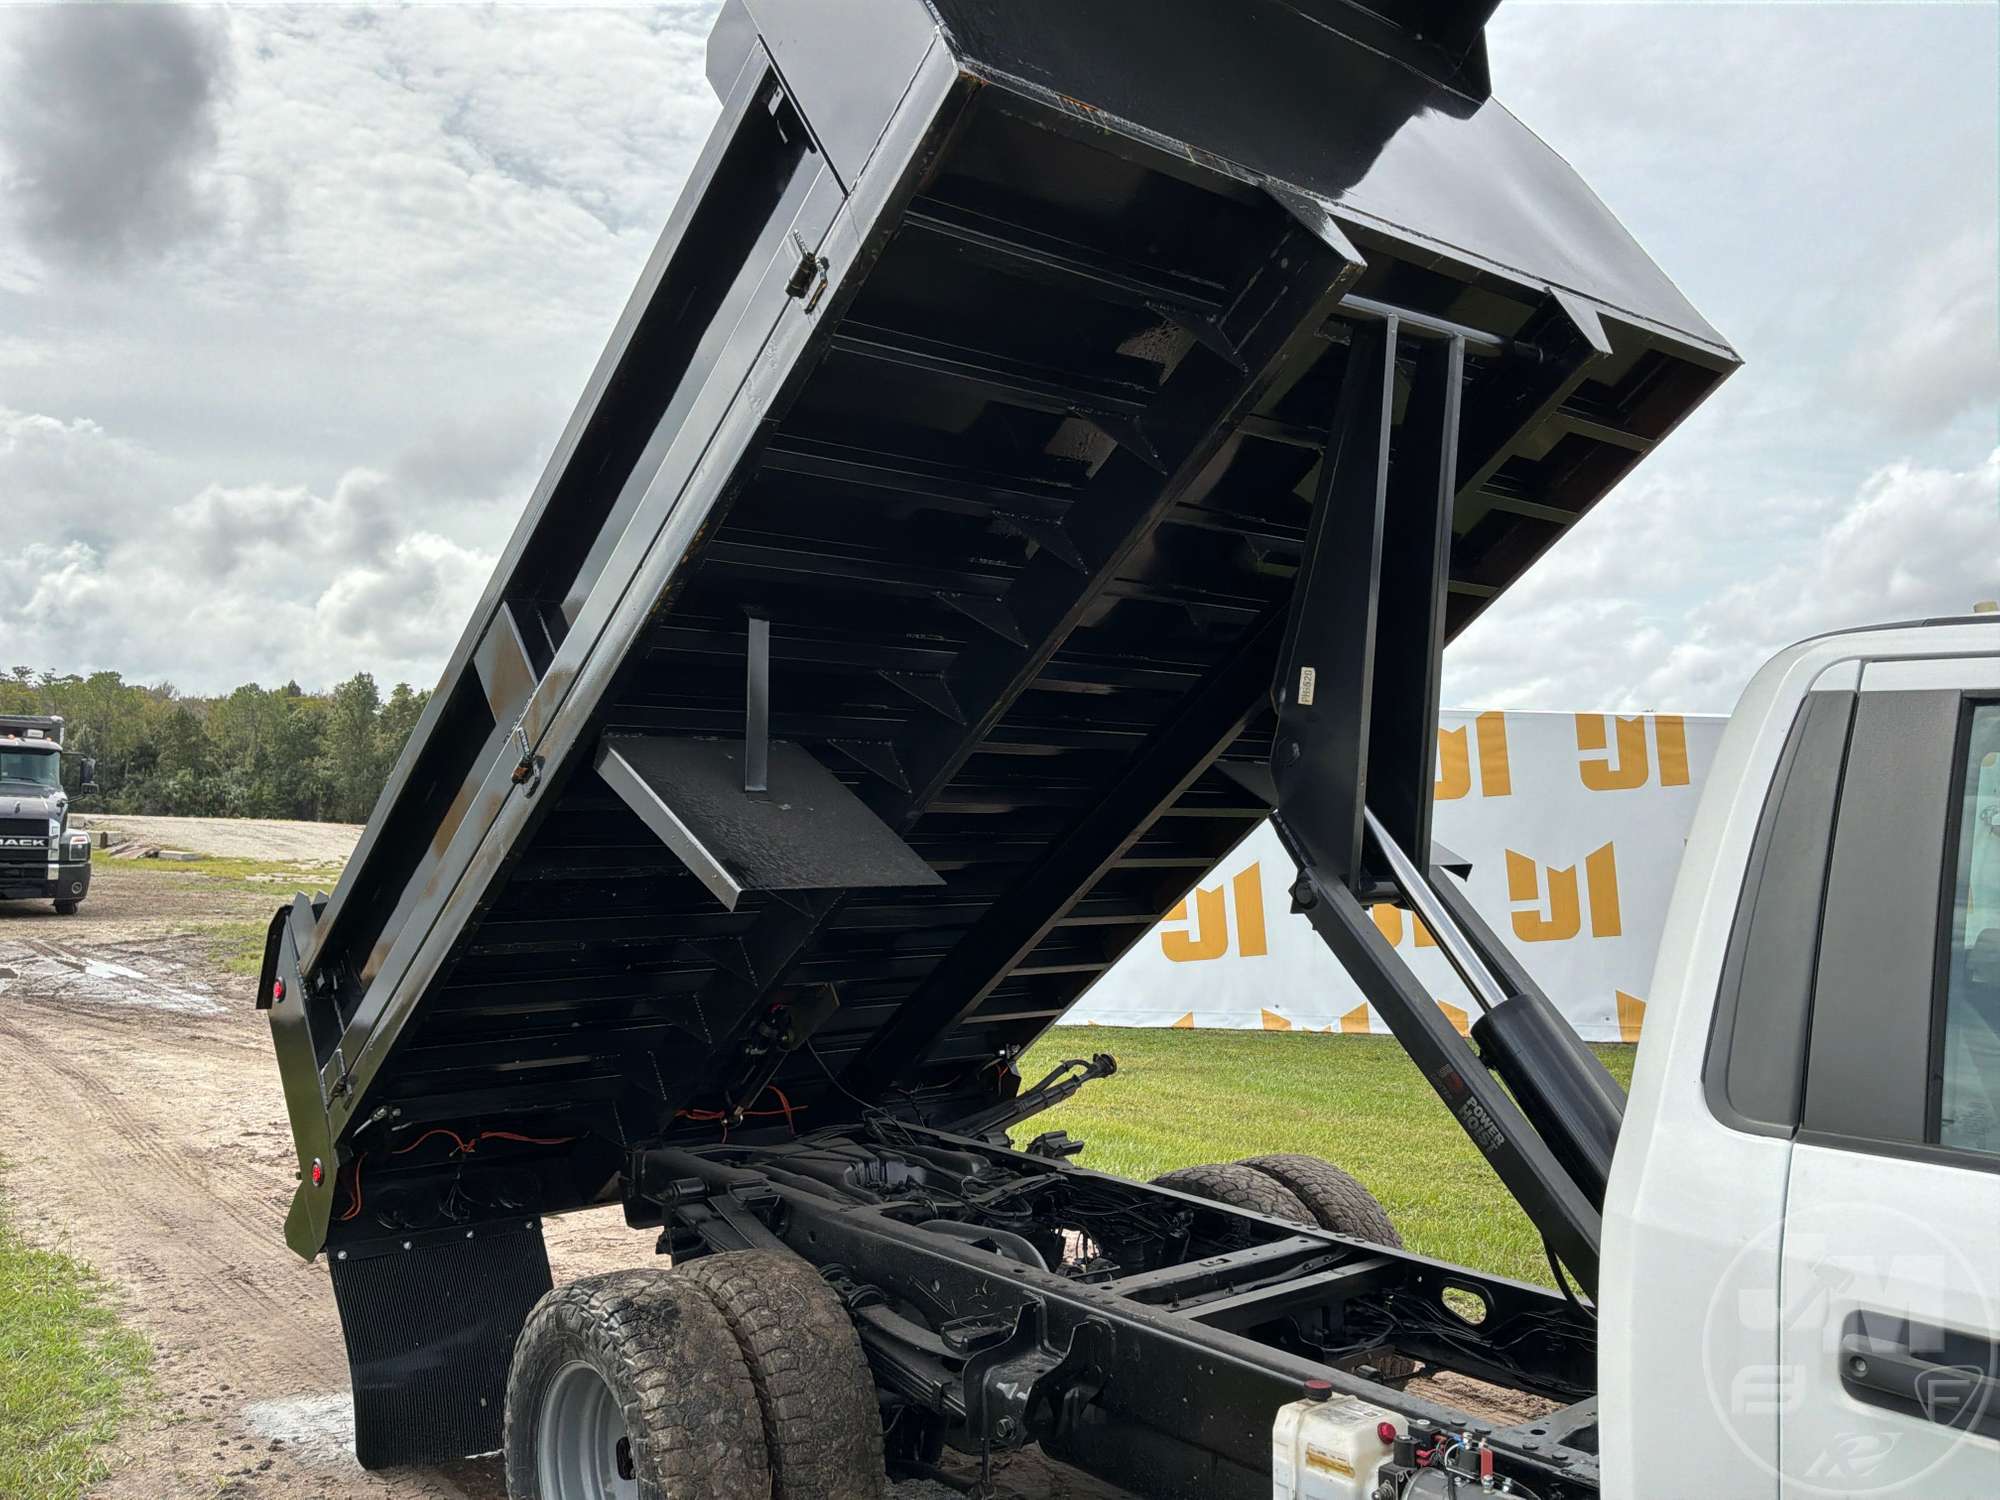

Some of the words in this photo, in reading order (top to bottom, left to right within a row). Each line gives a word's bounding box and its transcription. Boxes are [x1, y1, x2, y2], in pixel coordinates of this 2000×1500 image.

[0, 838, 45, 847] ACK
[1457, 1106, 1499, 1152] HOIST
[1466, 1096, 1505, 1145] POWER
